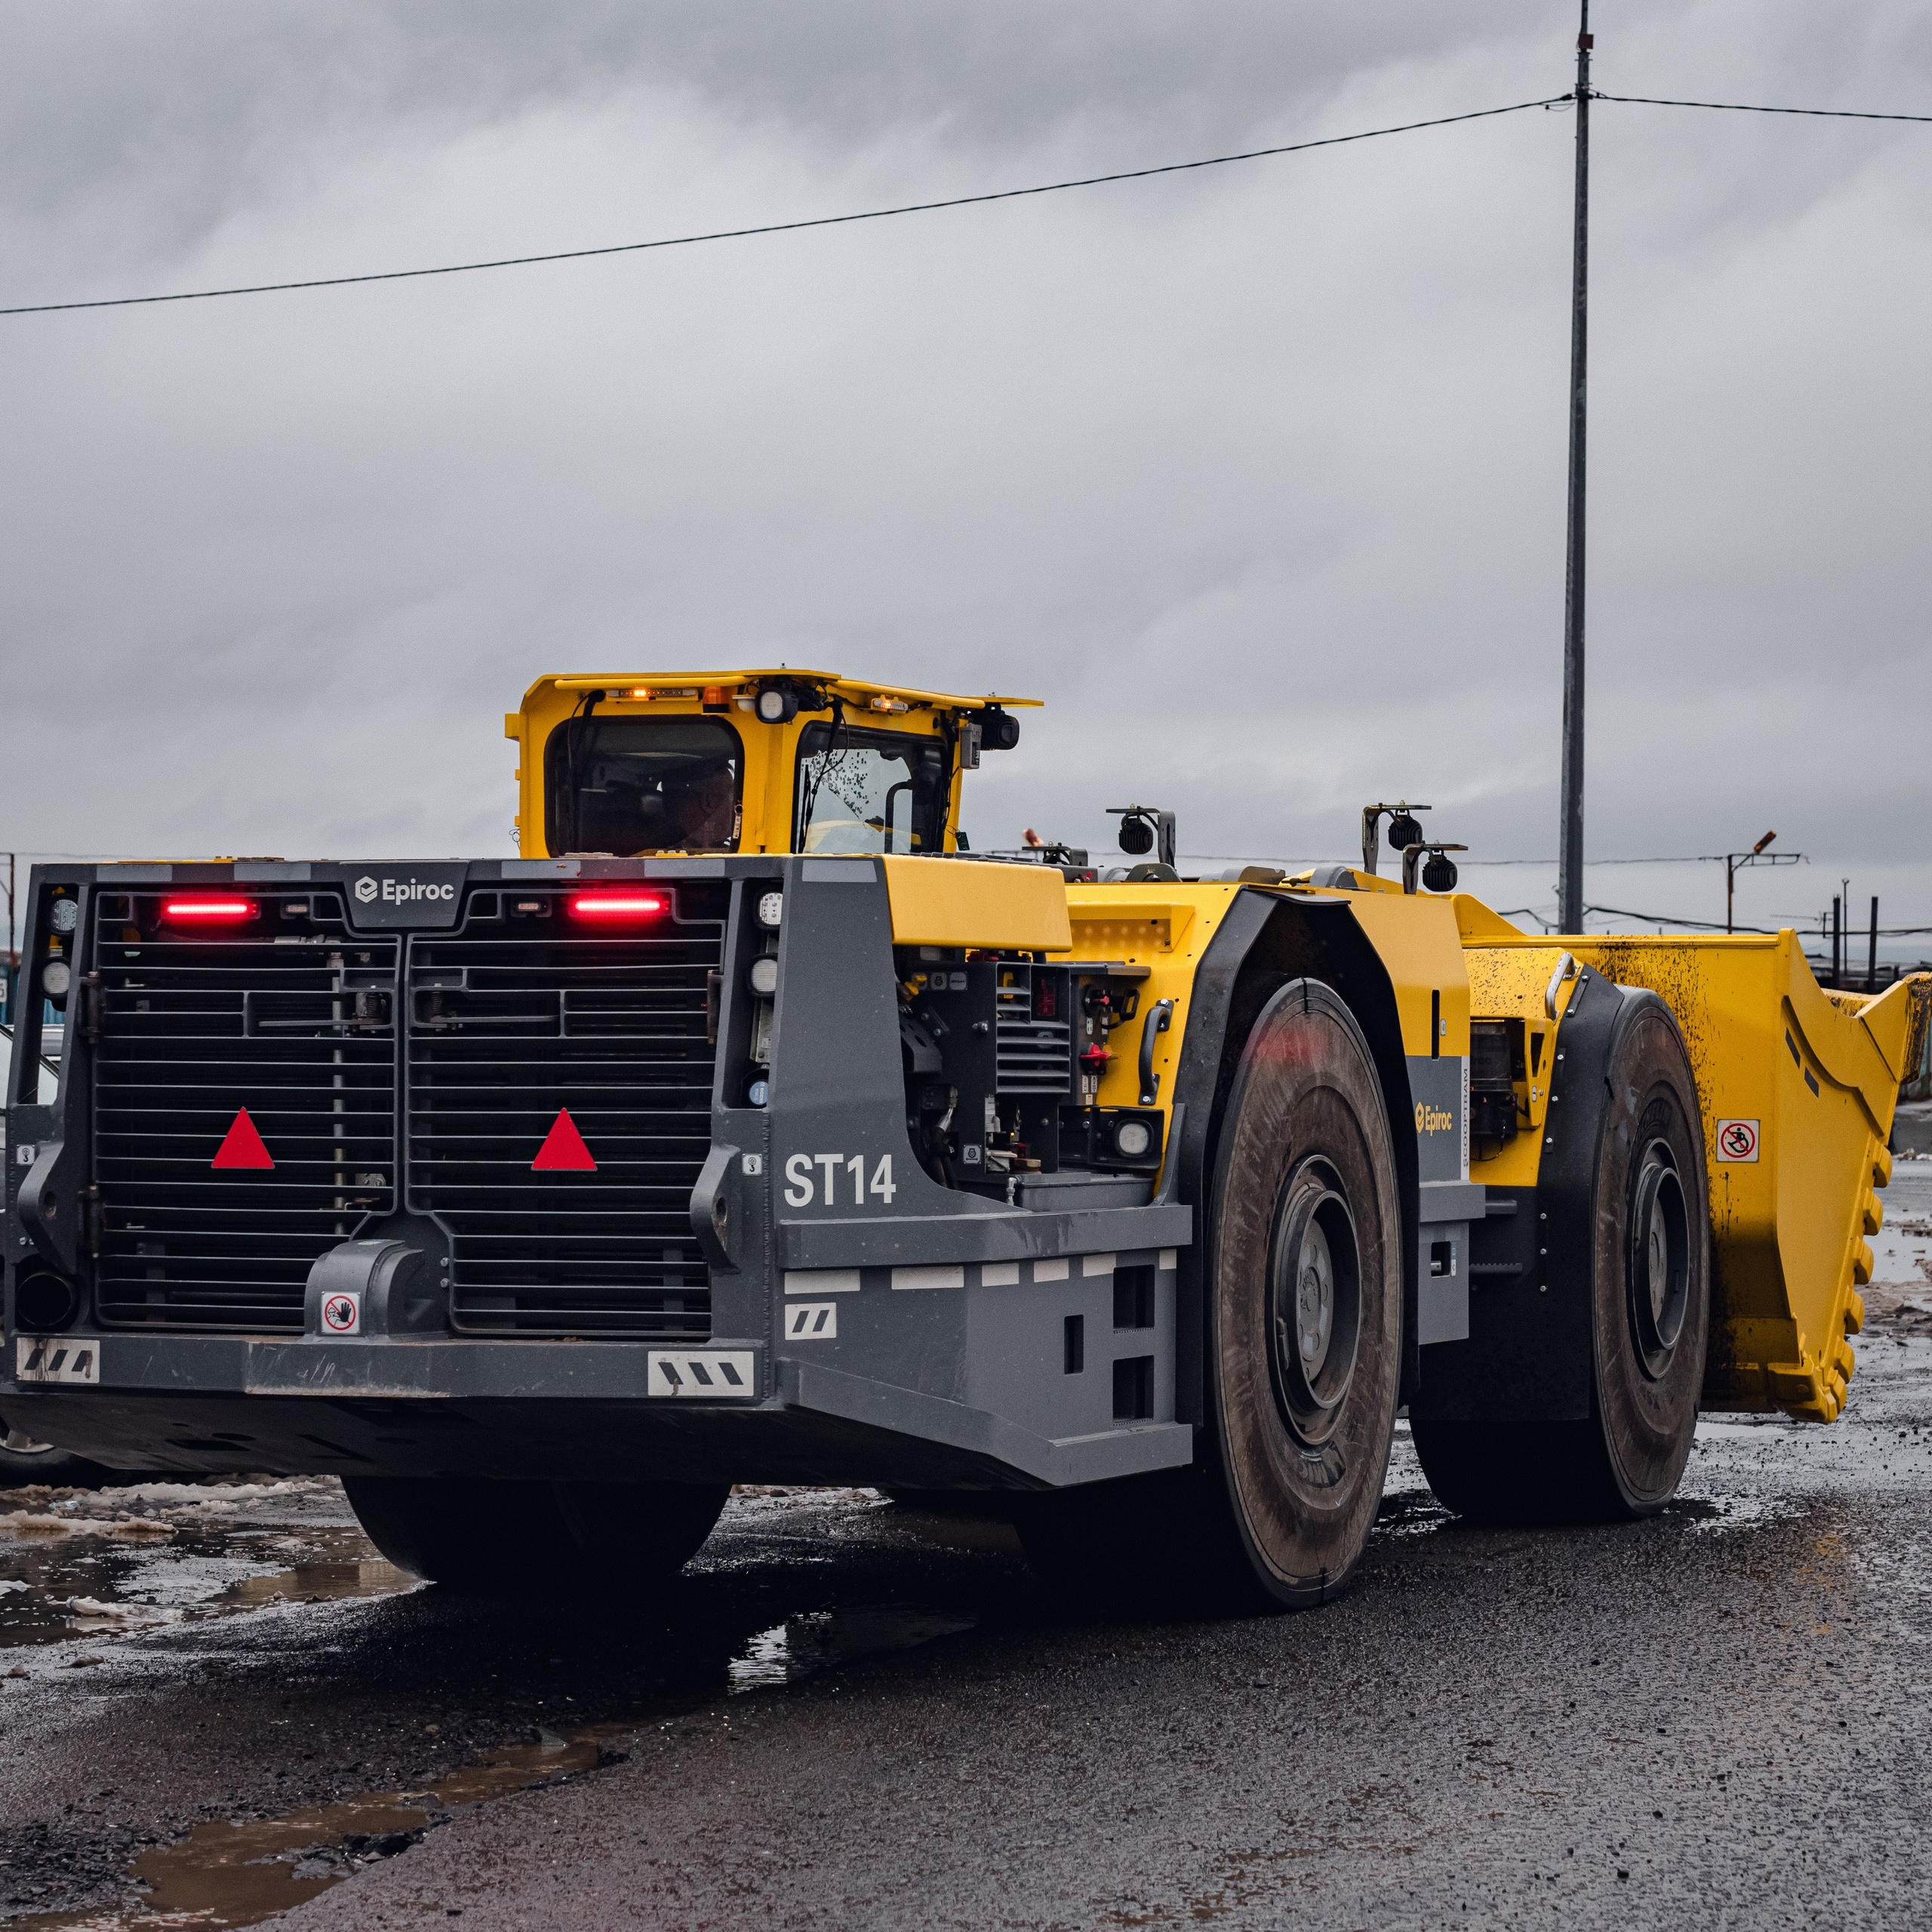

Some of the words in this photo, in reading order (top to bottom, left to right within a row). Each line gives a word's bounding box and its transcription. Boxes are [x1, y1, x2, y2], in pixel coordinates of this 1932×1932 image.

[382, 878, 454, 906] Epiroc
[1425, 1105, 1453, 1137] Epiroc
[784, 1153, 897, 1208] ST14
